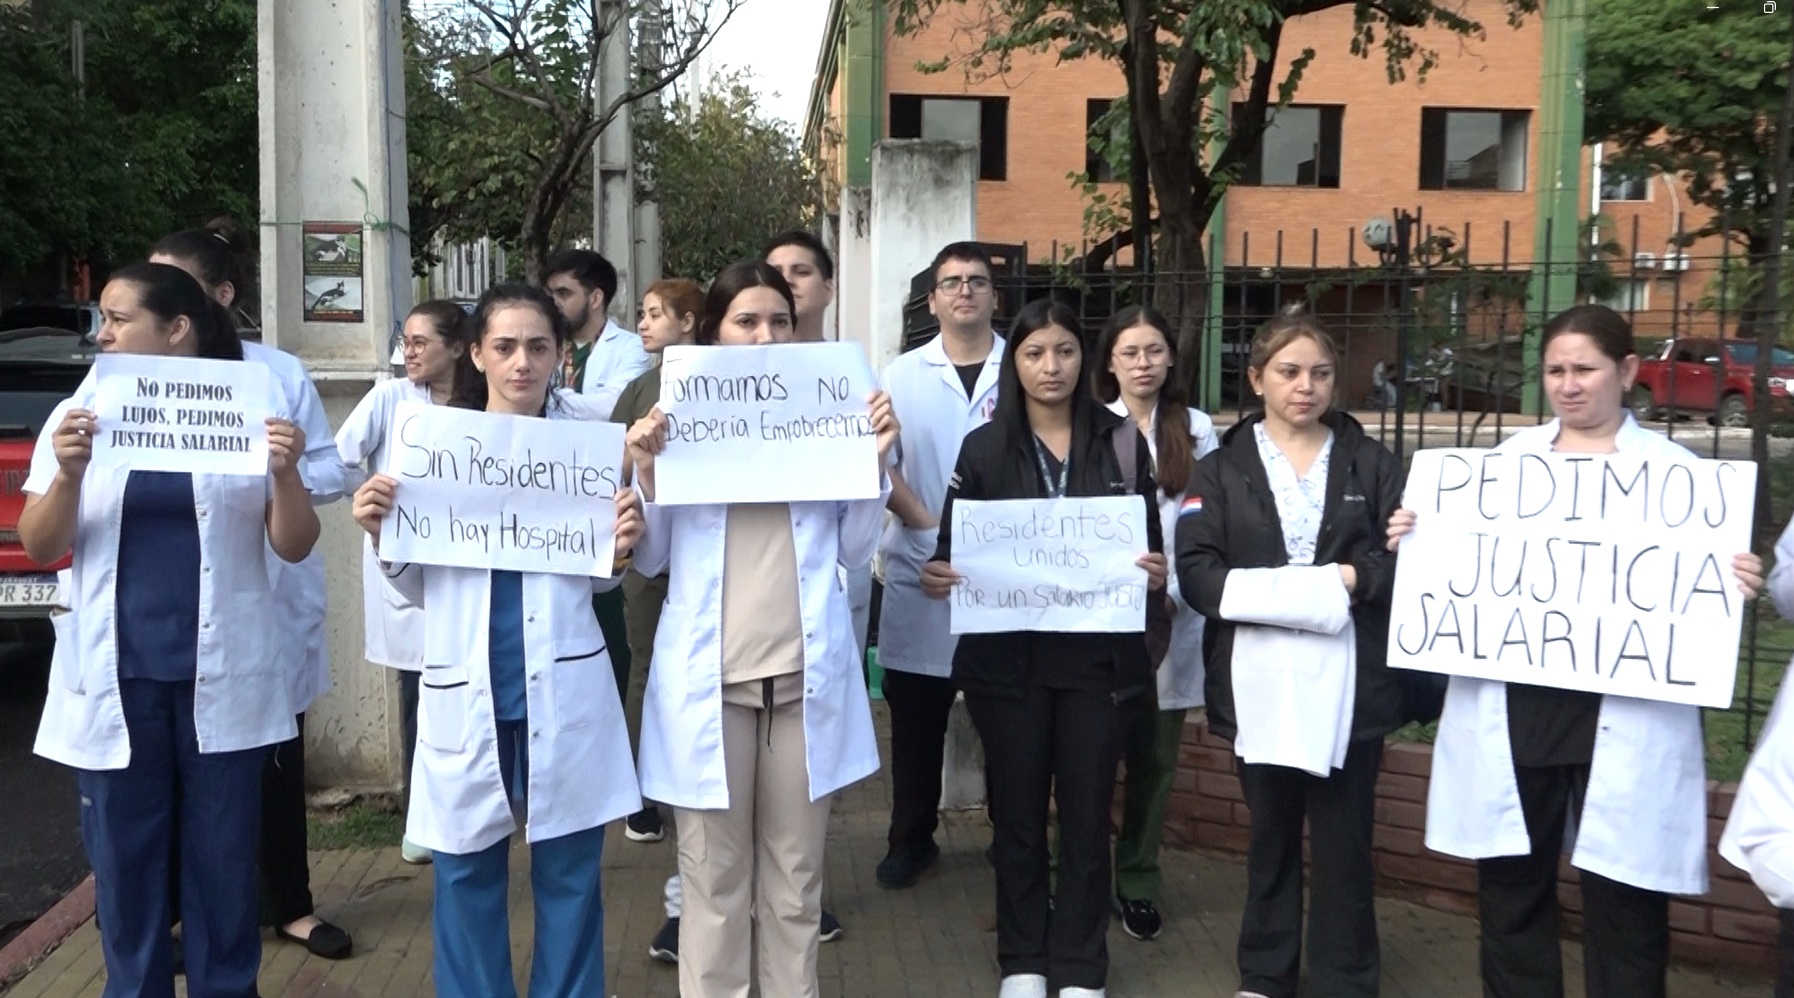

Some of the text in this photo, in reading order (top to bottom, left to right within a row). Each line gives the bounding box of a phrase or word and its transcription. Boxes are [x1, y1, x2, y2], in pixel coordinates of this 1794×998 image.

[165, 382, 233, 401] PEDIMOS
[122, 405, 244, 428] LUJOS, PEDIMOS
[110, 430, 252, 453] JUSTICIA SALARIAL
[400, 414, 618, 500] Sin Residentes
[1436, 452, 1737, 529] PEDIMOS
[396, 504, 597, 561] No hay Hospital
[960, 505, 1134, 545] Residentes
[22, 584, 57, 602] 337
[1448, 532, 1731, 618] JUSTICIA
[1396, 592, 1697, 686] SALARIAL
